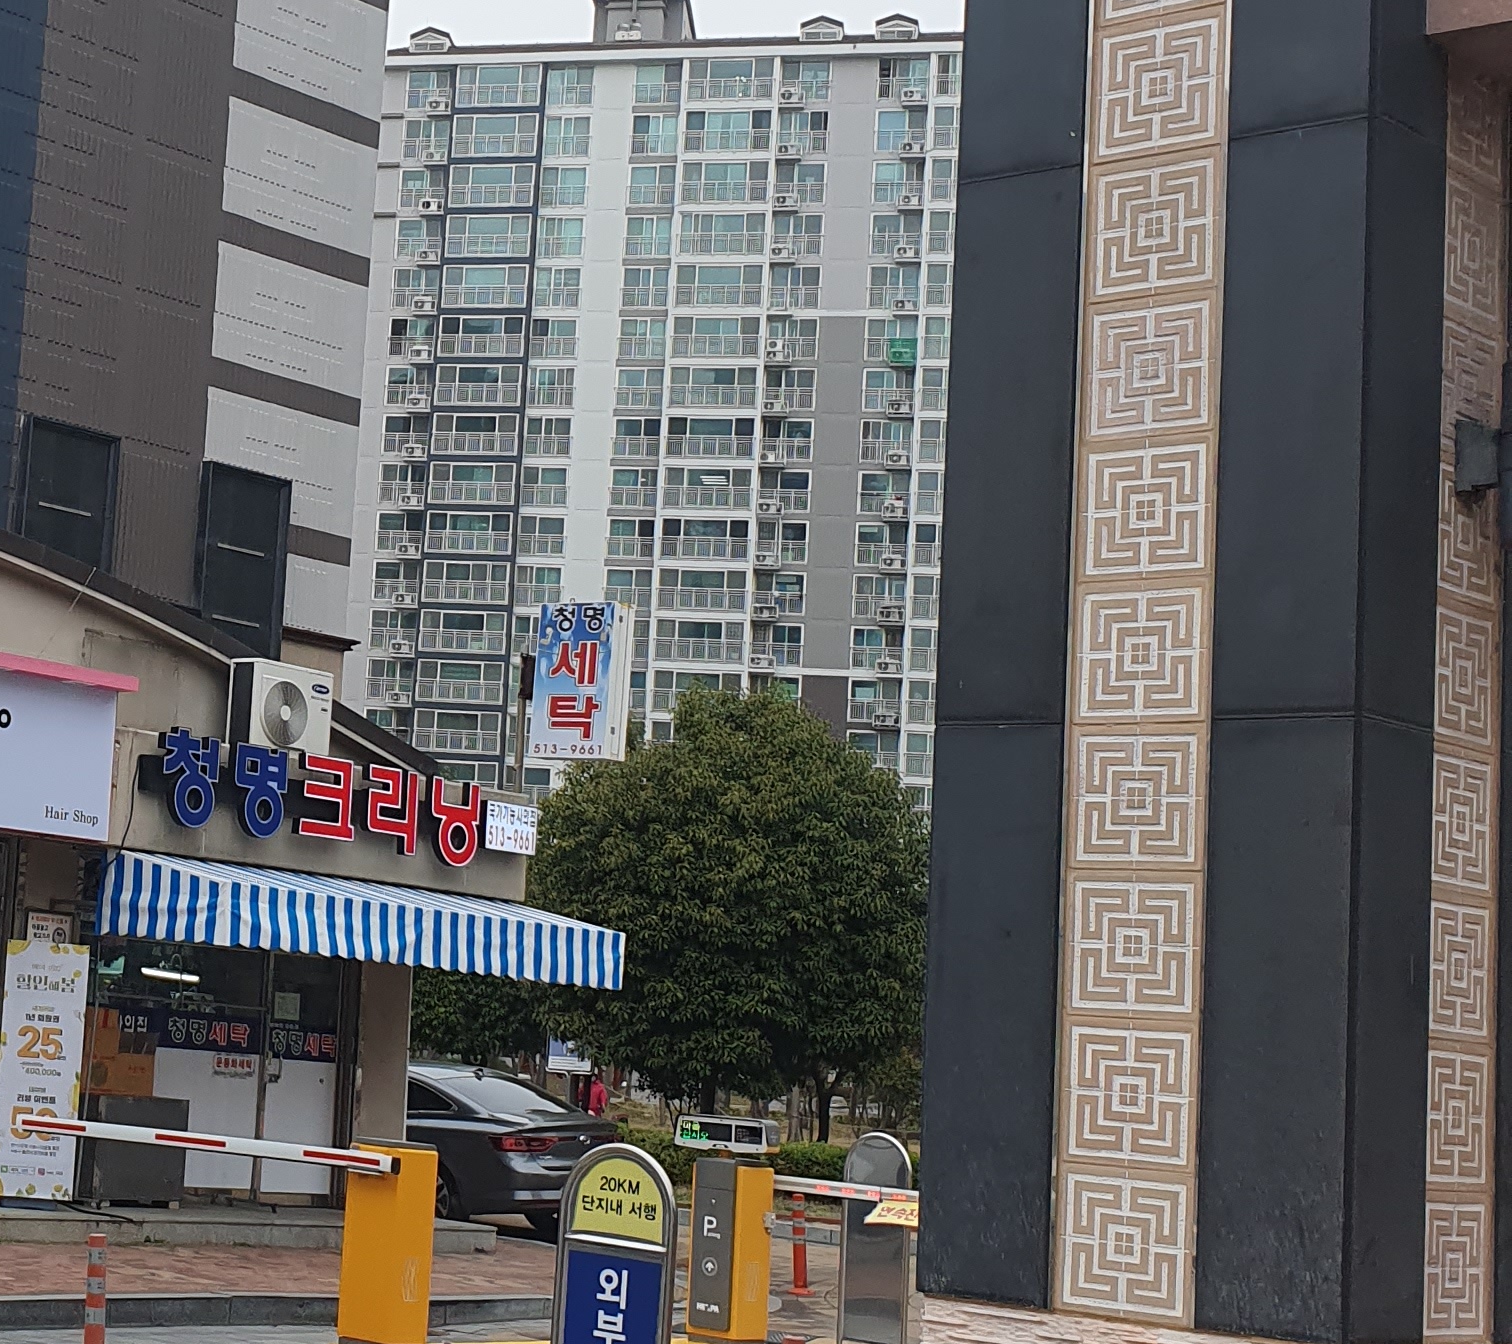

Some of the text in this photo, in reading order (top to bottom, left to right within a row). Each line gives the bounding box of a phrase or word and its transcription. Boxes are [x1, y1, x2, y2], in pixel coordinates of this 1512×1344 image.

[552, 605, 606, 633] 청명
[547, 640, 602, 742] 세탁
[533, 743, 603, 755] 513-9661
[162, 726, 481, 867] 청명크리닝
[45, 806, 99, 827] Hair Shop
[488, 825, 535, 852] 513-9661
[599, 1175, 641, 1196] 20KM
[581, 1194, 657, 1222] 단지내 서행
